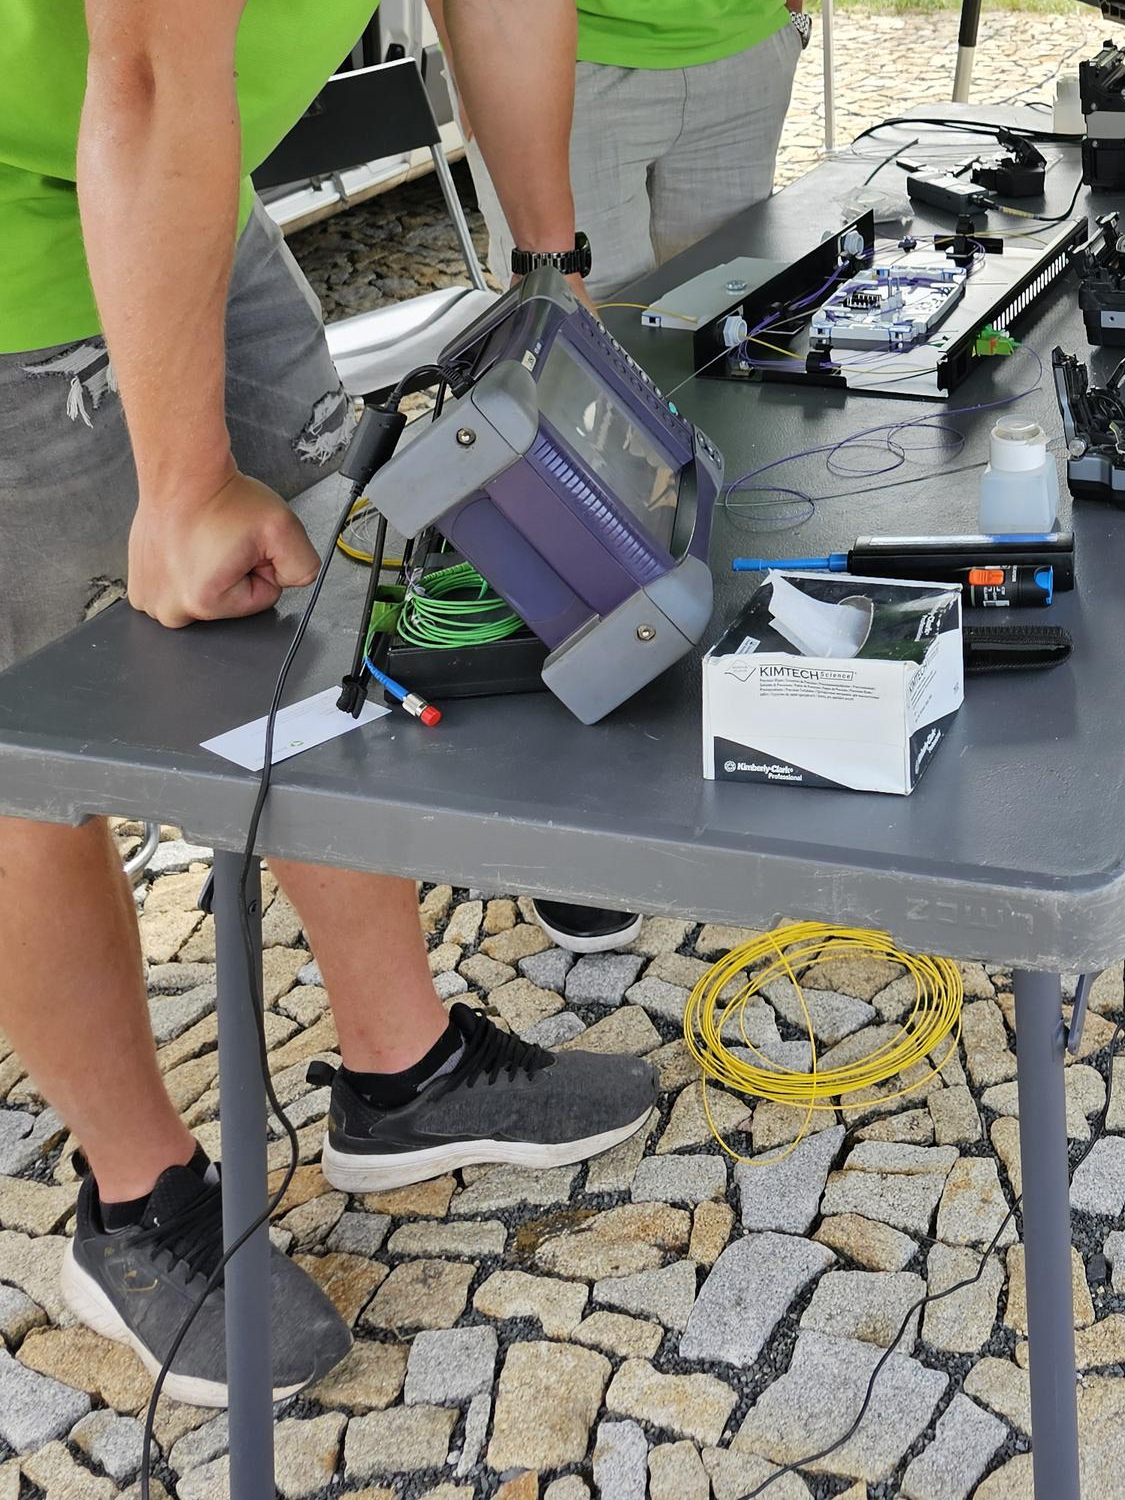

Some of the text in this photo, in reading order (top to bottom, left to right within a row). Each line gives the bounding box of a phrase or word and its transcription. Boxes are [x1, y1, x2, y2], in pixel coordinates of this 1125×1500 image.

[759, 666, 820, 680] KIMTECH
[820, 671, 852, 680] Science
[767, 773, 803, 781] Professional
